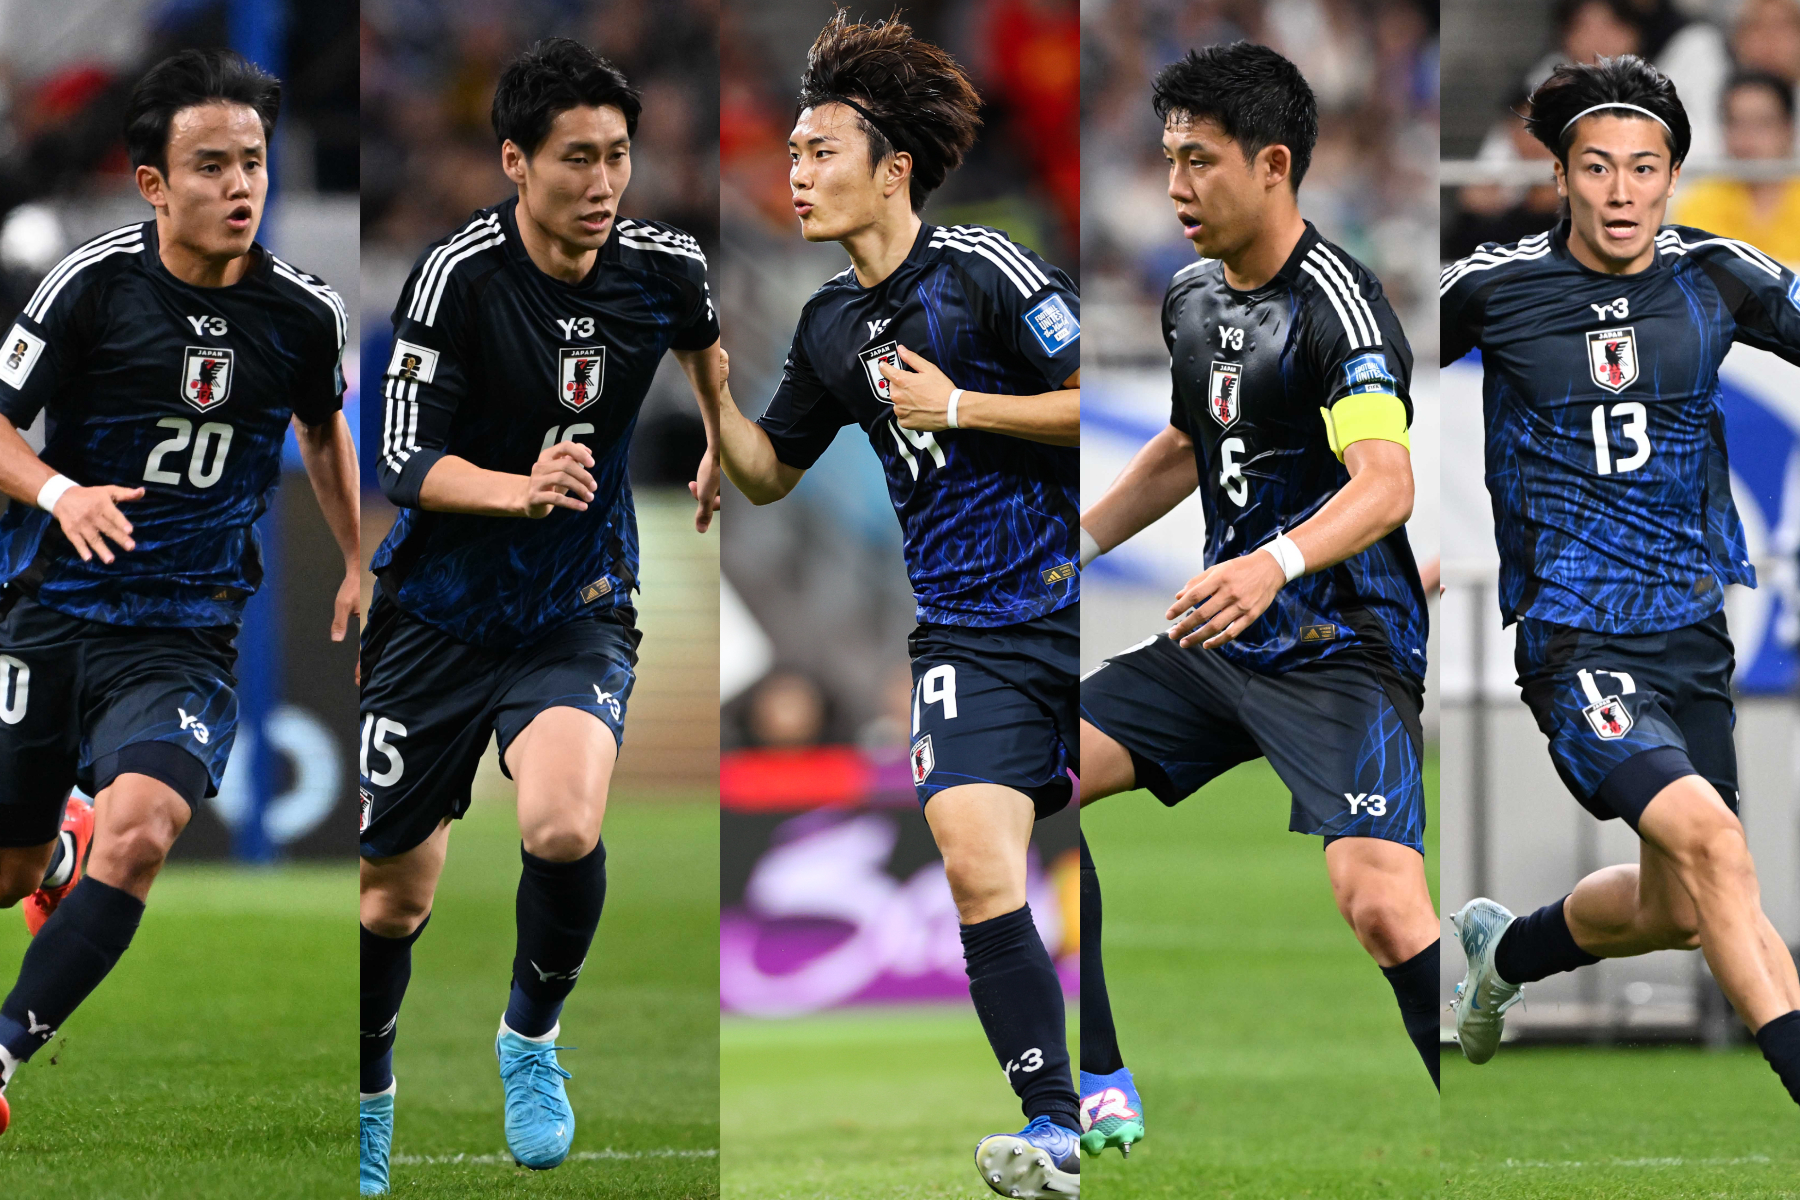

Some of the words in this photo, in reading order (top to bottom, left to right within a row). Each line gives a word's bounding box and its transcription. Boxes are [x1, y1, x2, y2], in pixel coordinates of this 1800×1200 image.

[1591, 297, 1629, 321] Y-3
[186, 315, 228, 336] Y-3
[556, 316, 595, 340] Y-3
[1598, 331, 1623, 340] JAPAN
[1218, 325, 1245, 351] Y-3
[571, 349, 595, 357] JAPAN
[870, 345, 890, 358] JAPAN
[1219, 364, 1237, 373] JAPAN
[193, 390, 215, 401] JFA
[570, 391, 589, 401] JFA
[1218, 407, 1232, 418] JFA
[1591, 402, 1651, 475] 13
[143, 417, 233, 489] 20
[1219, 437, 1249, 508] 6
[593, 683, 622, 721] Y-3
[912, 664, 958, 738] 19
[177, 707, 210, 744] Y-3
[360, 712, 408, 787] 15
[1343, 792, 1387, 817] Y-3
